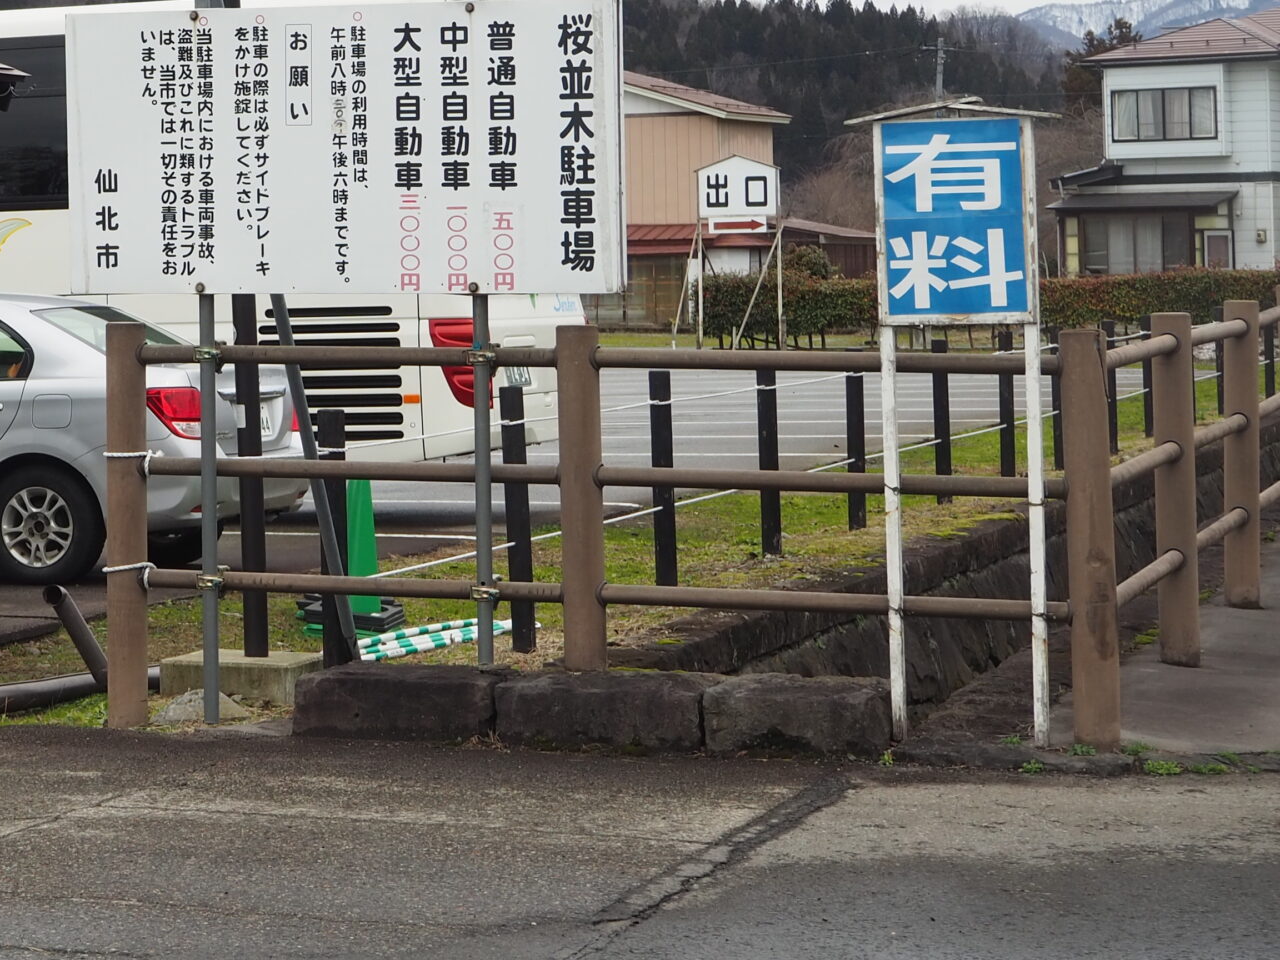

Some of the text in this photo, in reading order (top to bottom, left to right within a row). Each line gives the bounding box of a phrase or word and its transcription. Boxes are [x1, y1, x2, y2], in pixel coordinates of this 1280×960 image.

[140, 30, 157, 106] いません。
[158, 29, 178, 276] は、当市では一切その責任をお
[177, 28, 196, 276] 盗難及びこれに類するトラブル
[196, 27, 215, 265] 当駐車場内における車両事故、
[233, 26, 253, 231] をかけ施錠してください。
[252, 26, 271, 277] 駐車の際は必ずサイドブレーキ
[288, 31, 309, 120] お願い
[393, 22, 423, 191] 大型自動車
[439, 21, 470, 191] 中型自動車
[486, 20, 518, 192] 普通自動車
[557, 13, 596, 273] 桜並木駐車場
[94, 168, 120, 269] 仙北市
[705, 172, 768, 208] 出口
[884, 134, 1023, 309] 有料
